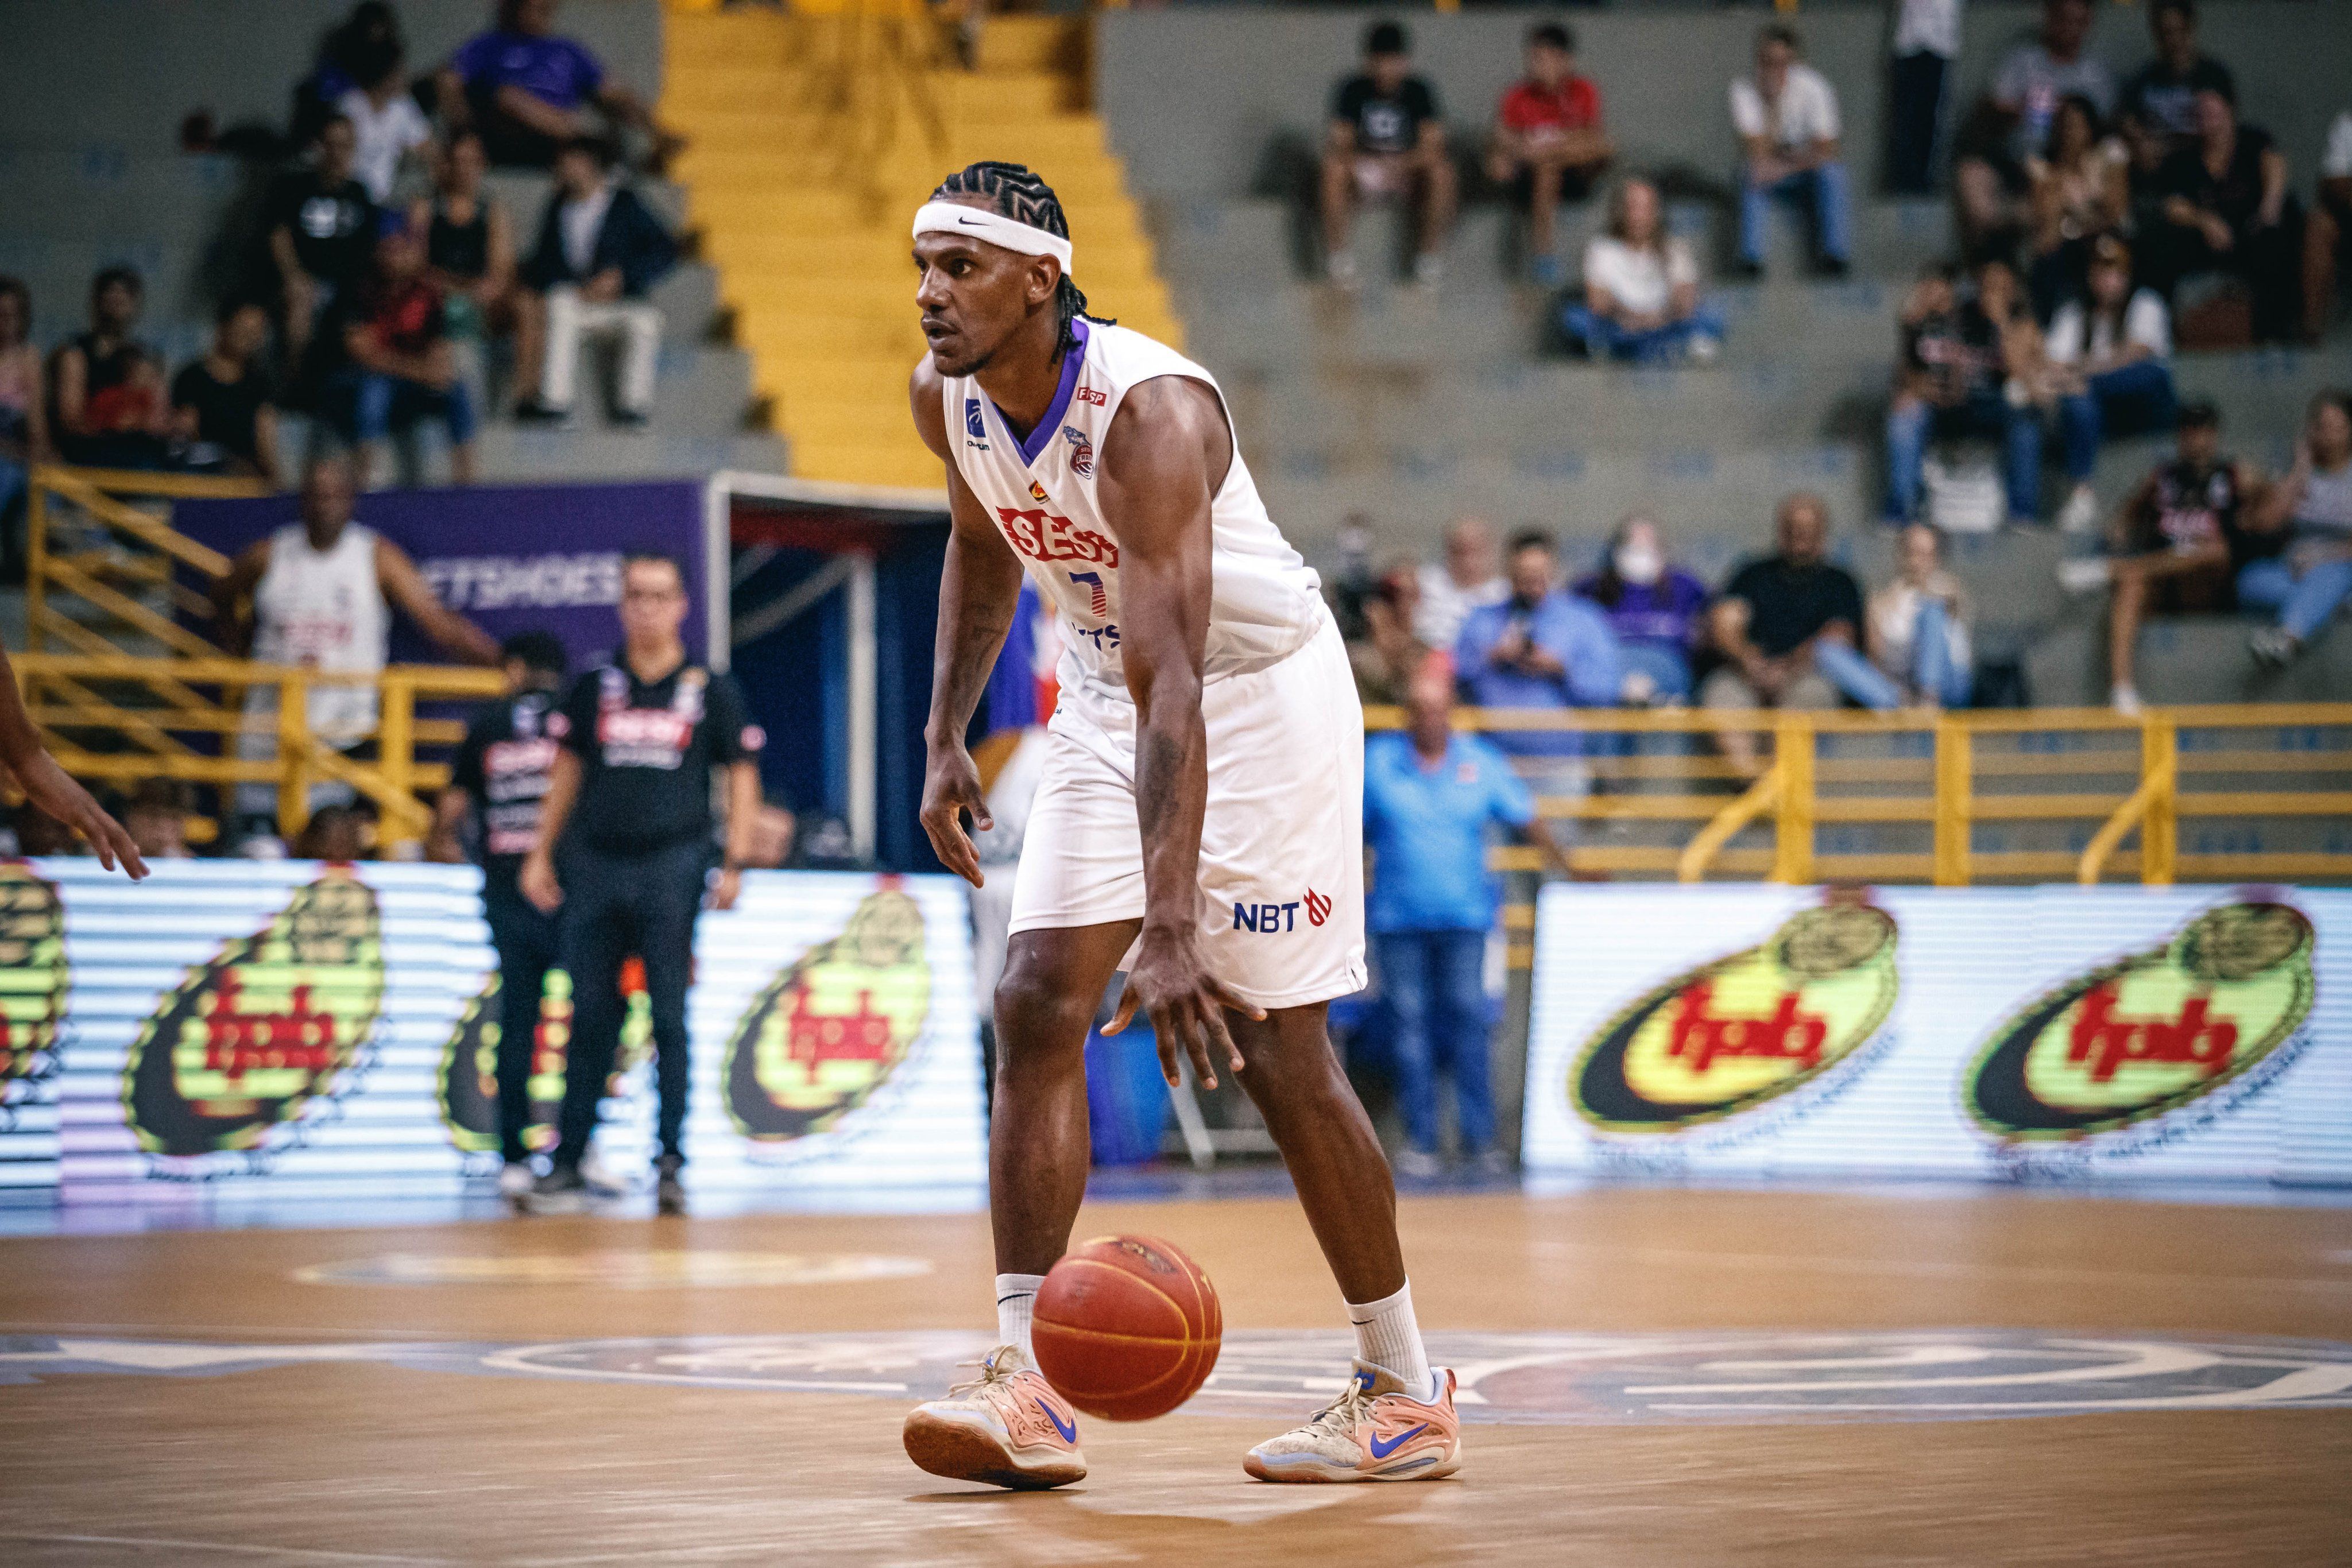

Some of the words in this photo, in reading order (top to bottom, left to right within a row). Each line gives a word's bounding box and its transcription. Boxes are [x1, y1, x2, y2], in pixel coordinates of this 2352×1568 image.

[1068, 571, 1107, 620] 7
[1233, 901, 1299, 934] NBT
[1670, 979, 1827, 1072] fpb
[2069, 984, 2237, 1080] fpb
